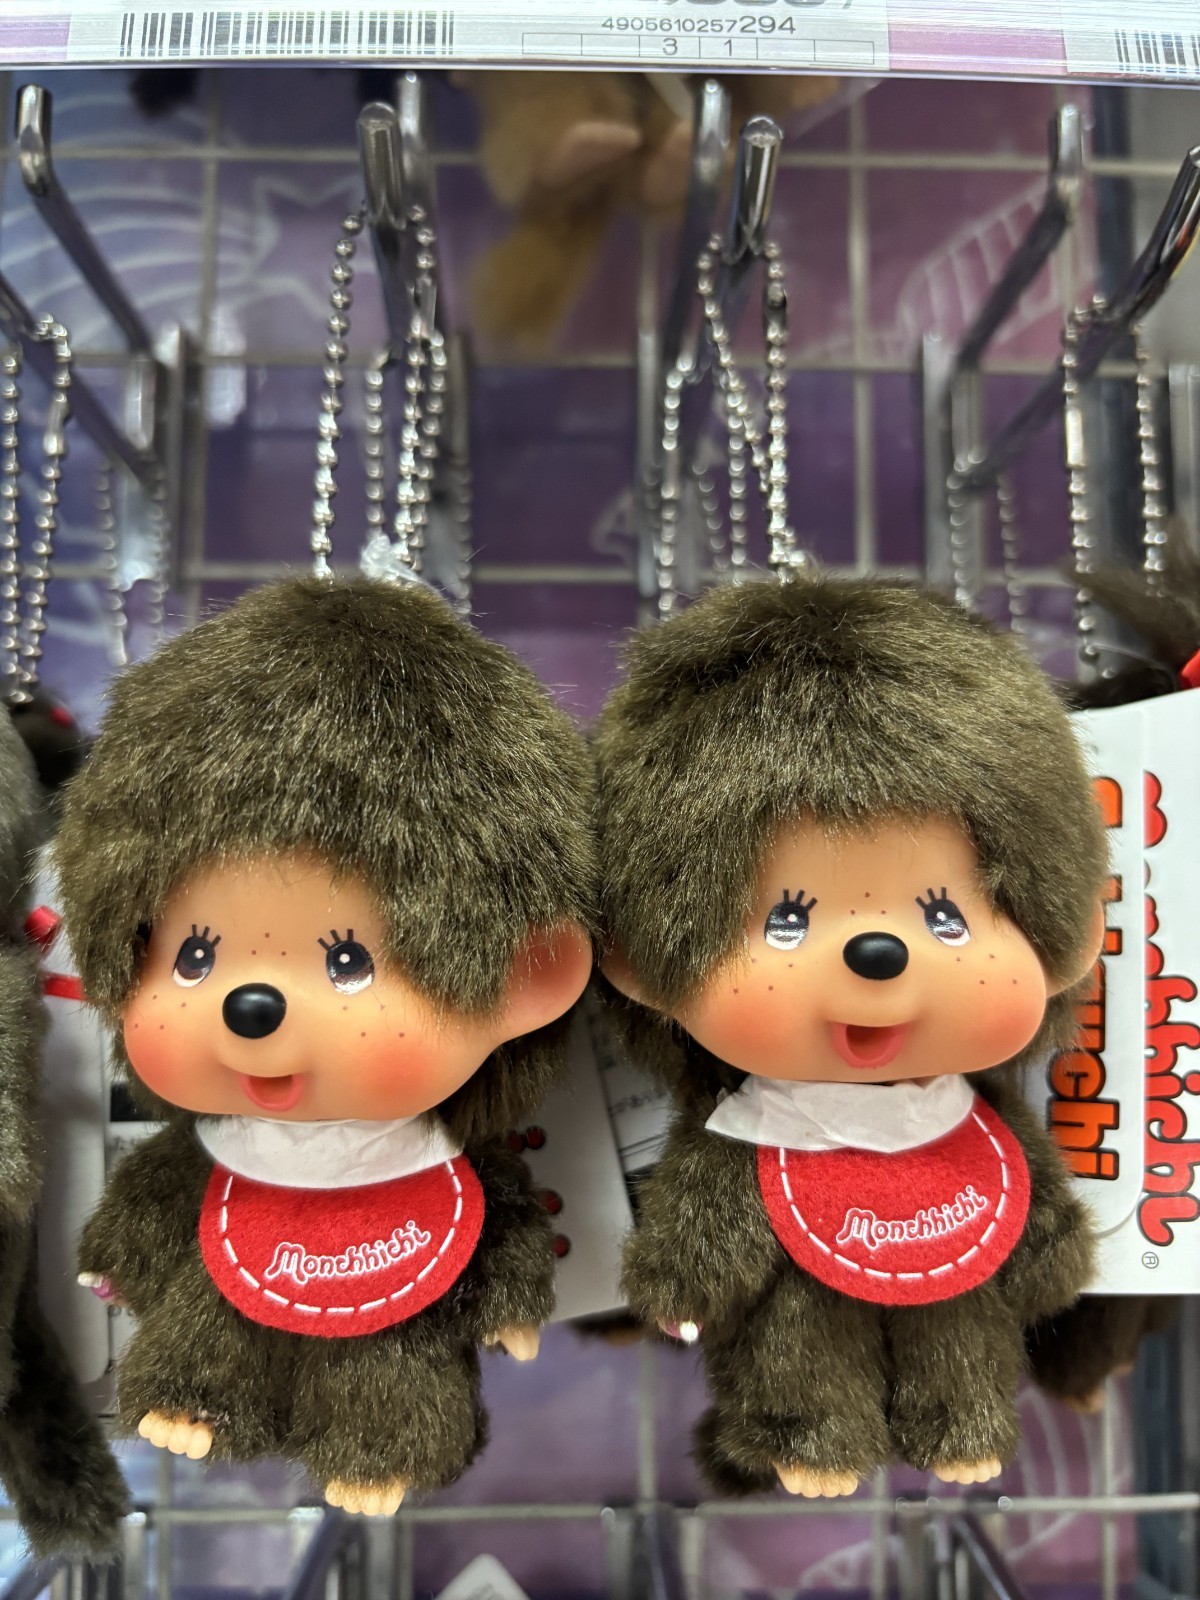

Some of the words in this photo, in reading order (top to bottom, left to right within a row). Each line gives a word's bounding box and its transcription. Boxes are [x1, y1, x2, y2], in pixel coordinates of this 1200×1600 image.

[601, 15, 797, 35] 4905610257294
[661, 37, 679, 57] 3
[722, 38, 734, 58] 1
[836, 1184, 988, 1250] Monchhichi
[264, 1219, 431, 1286] Monchhichi
